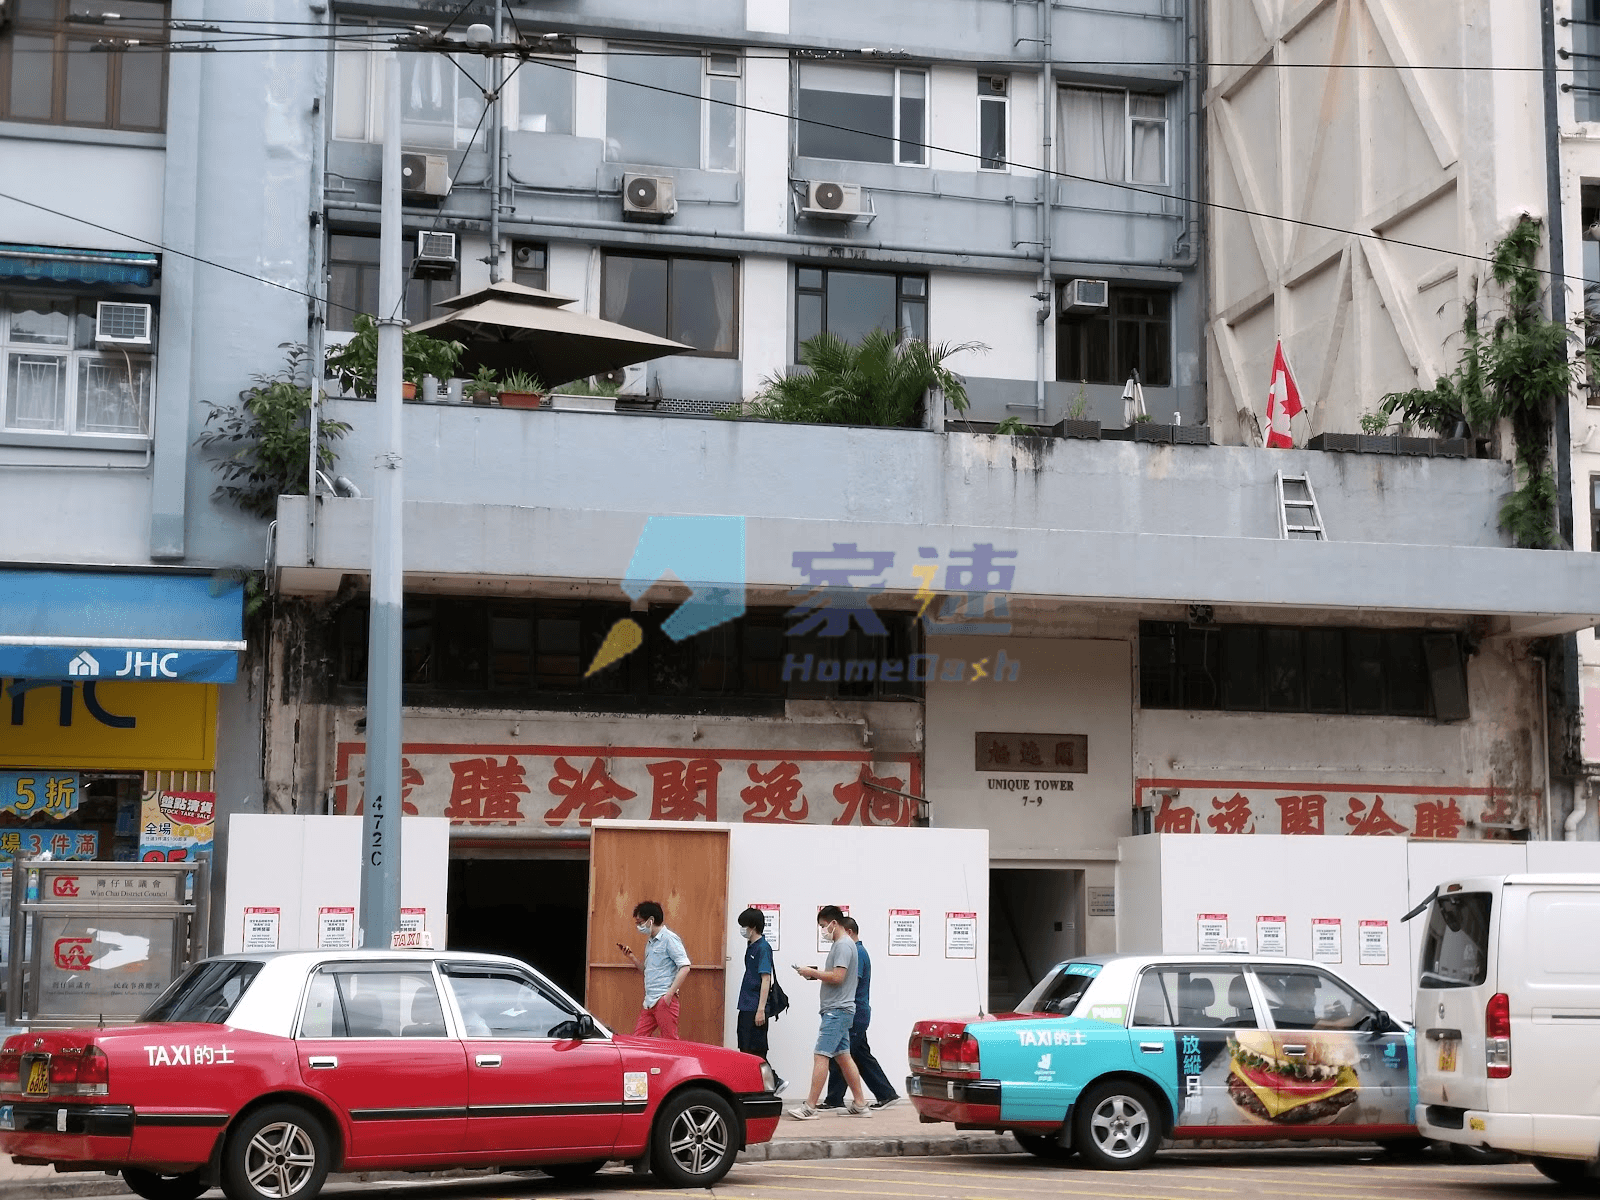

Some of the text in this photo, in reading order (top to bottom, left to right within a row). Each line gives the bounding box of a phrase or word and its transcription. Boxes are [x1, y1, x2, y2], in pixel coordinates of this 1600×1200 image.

[116, 651, 179, 677] JHC
[987, 778, 1074, 792] UNIQUE TOWER
[15, 778, 75, 810] 5折
[1022, 796, 1043, 807] 7-9
[160, 806, 211, 820] STOCK TAKE SALE
[145, 822, 172, 835] 全場
[370, 795, 384, 867] 472C
[97, 879, 162, 888] 灣仔區議會
[393, 932, 421, 947] TAXI
[1018, 1029, 1087, 1047] TAXI 的士
[144, 1044, 235, 1066] TAXI 的士
